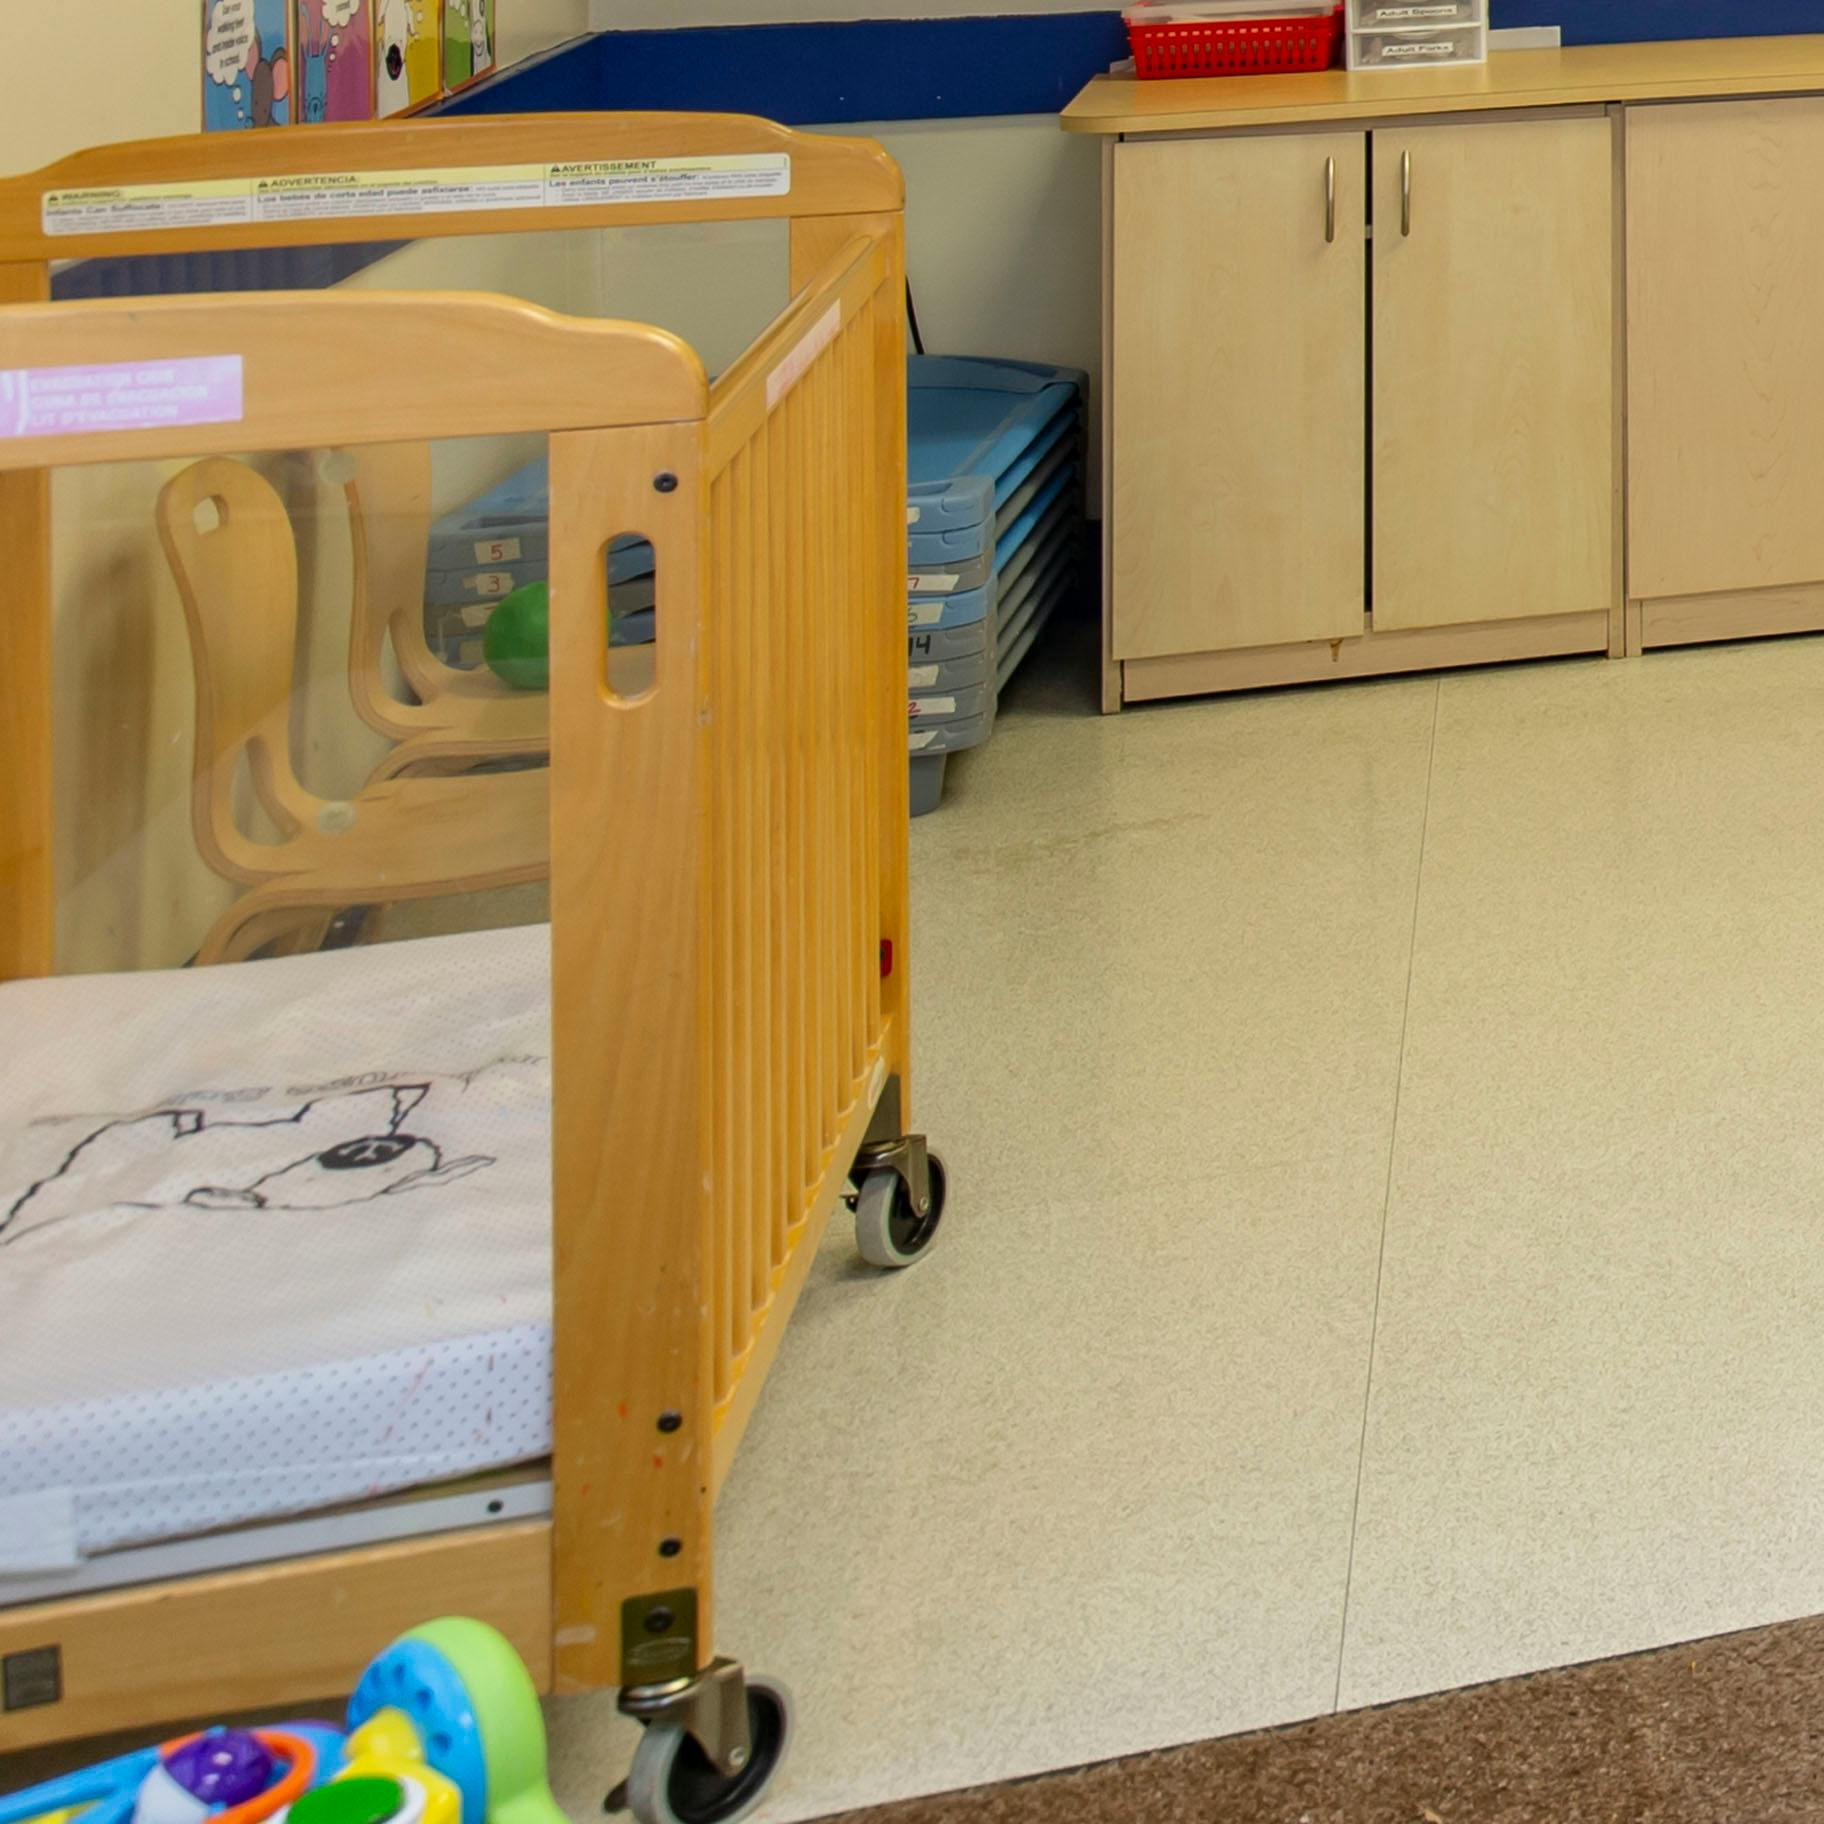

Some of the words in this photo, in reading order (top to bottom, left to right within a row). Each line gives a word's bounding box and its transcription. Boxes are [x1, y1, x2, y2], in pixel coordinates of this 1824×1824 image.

[1380, 9, 1408, 18] Adult
[1411, 6, 1454, 17] Spoons
[1386, 45, 1415, 54] Adult
[1418, 42, 1450, 52] Forks
[561, 161, 657, 173] AVERTISSEMENT
[490, 544, 503, 561] 5
[488, 575, 500, 593] 3
